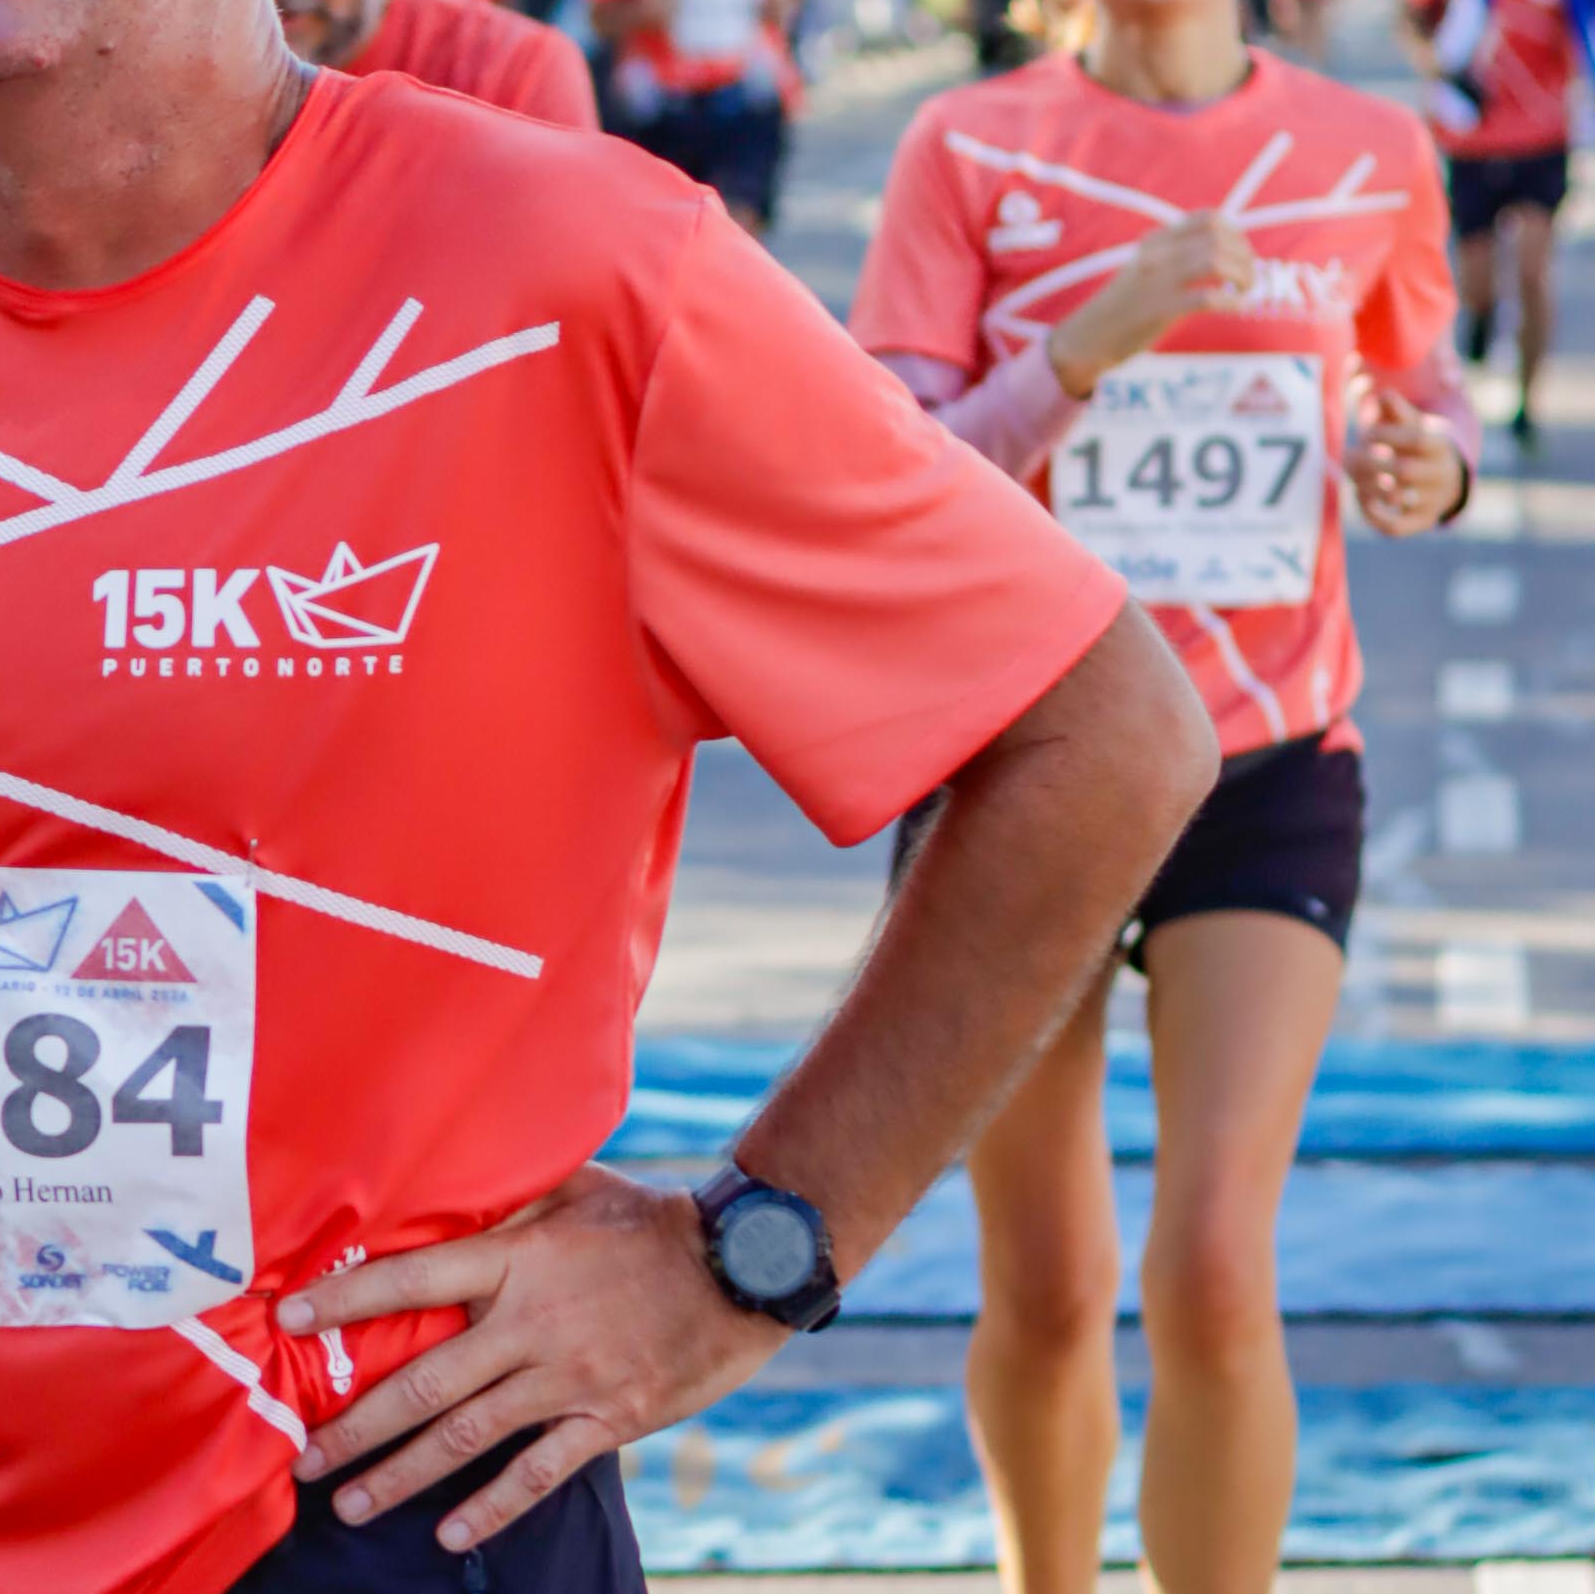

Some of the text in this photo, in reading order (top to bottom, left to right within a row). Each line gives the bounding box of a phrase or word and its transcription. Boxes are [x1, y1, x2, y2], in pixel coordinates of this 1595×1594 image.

[1069, 434, 1309, 509] 1497
[92, 567, 262, 650] 15K
[101, 653, 405, 678] PUERTO NORTE
[101, 937, 169, 972] 15K
[13, 1177, 114, 1205] Hernan
